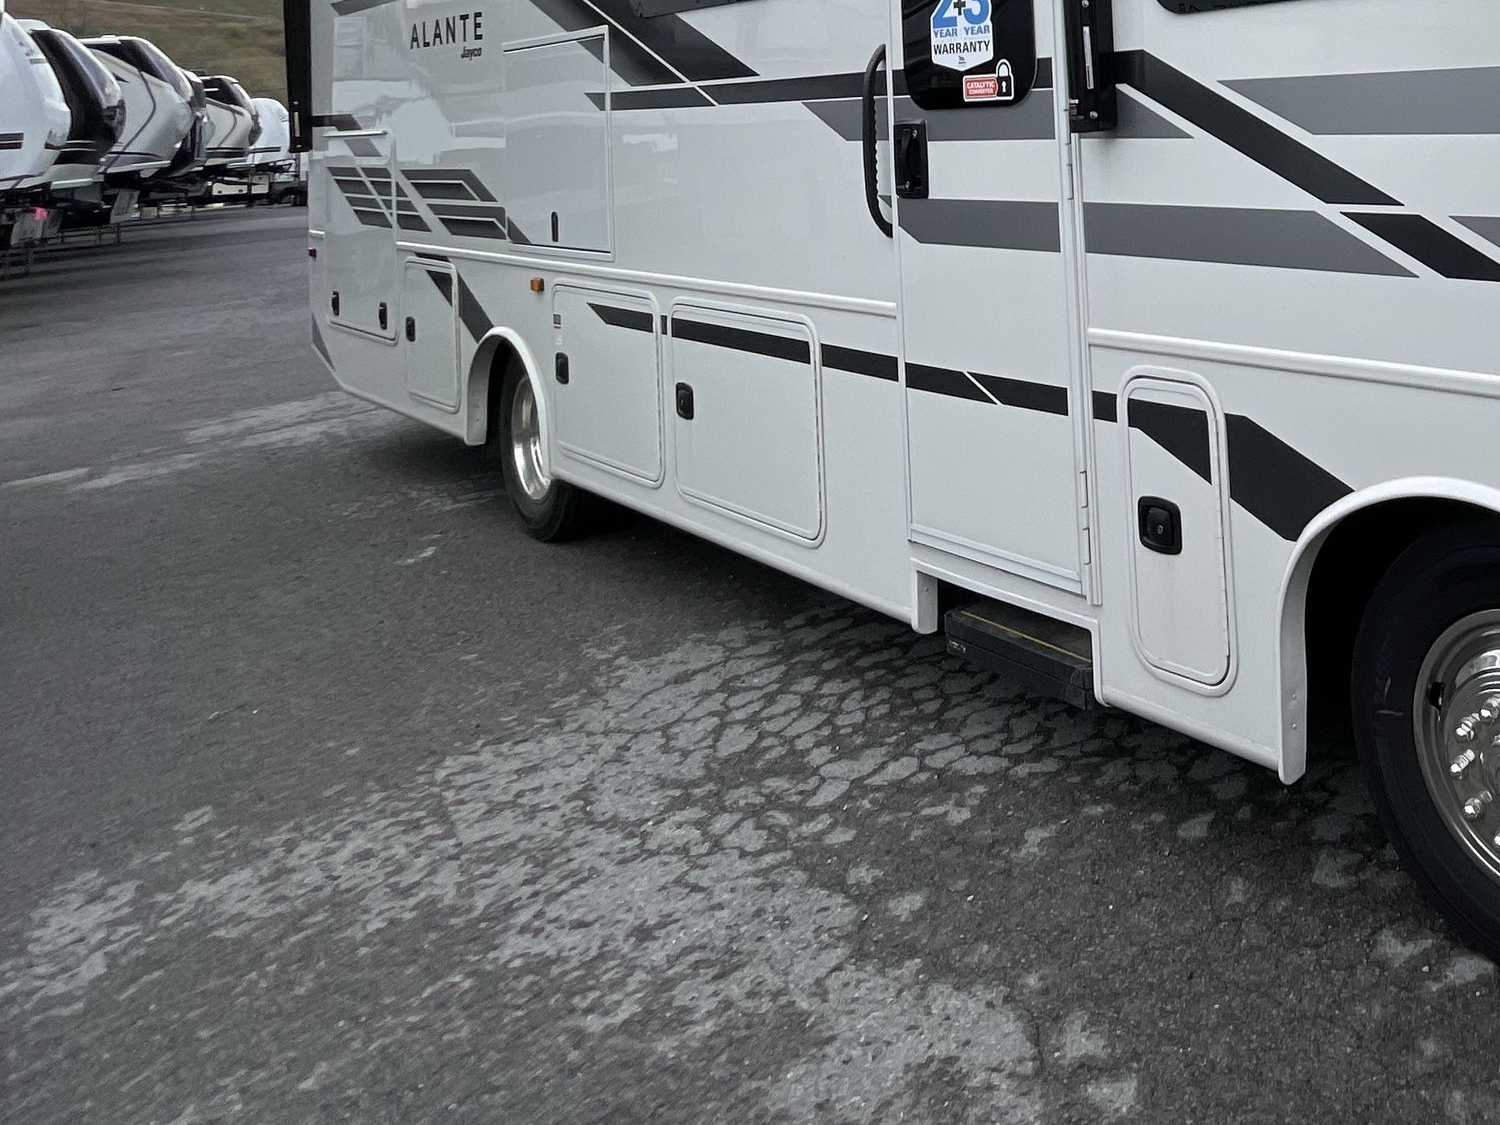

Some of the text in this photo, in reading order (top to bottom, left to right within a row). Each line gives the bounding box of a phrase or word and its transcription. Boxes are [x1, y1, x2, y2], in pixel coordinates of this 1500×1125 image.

[410, 11, 483, 50] ALANTE
[933, 25, 990, 38] YEAR YEAR
[461, 46, 482, 60] Jayco
[933, 40, 991, 56] WARRANTY
[966, 80, 996, 89] CATALYTIC
